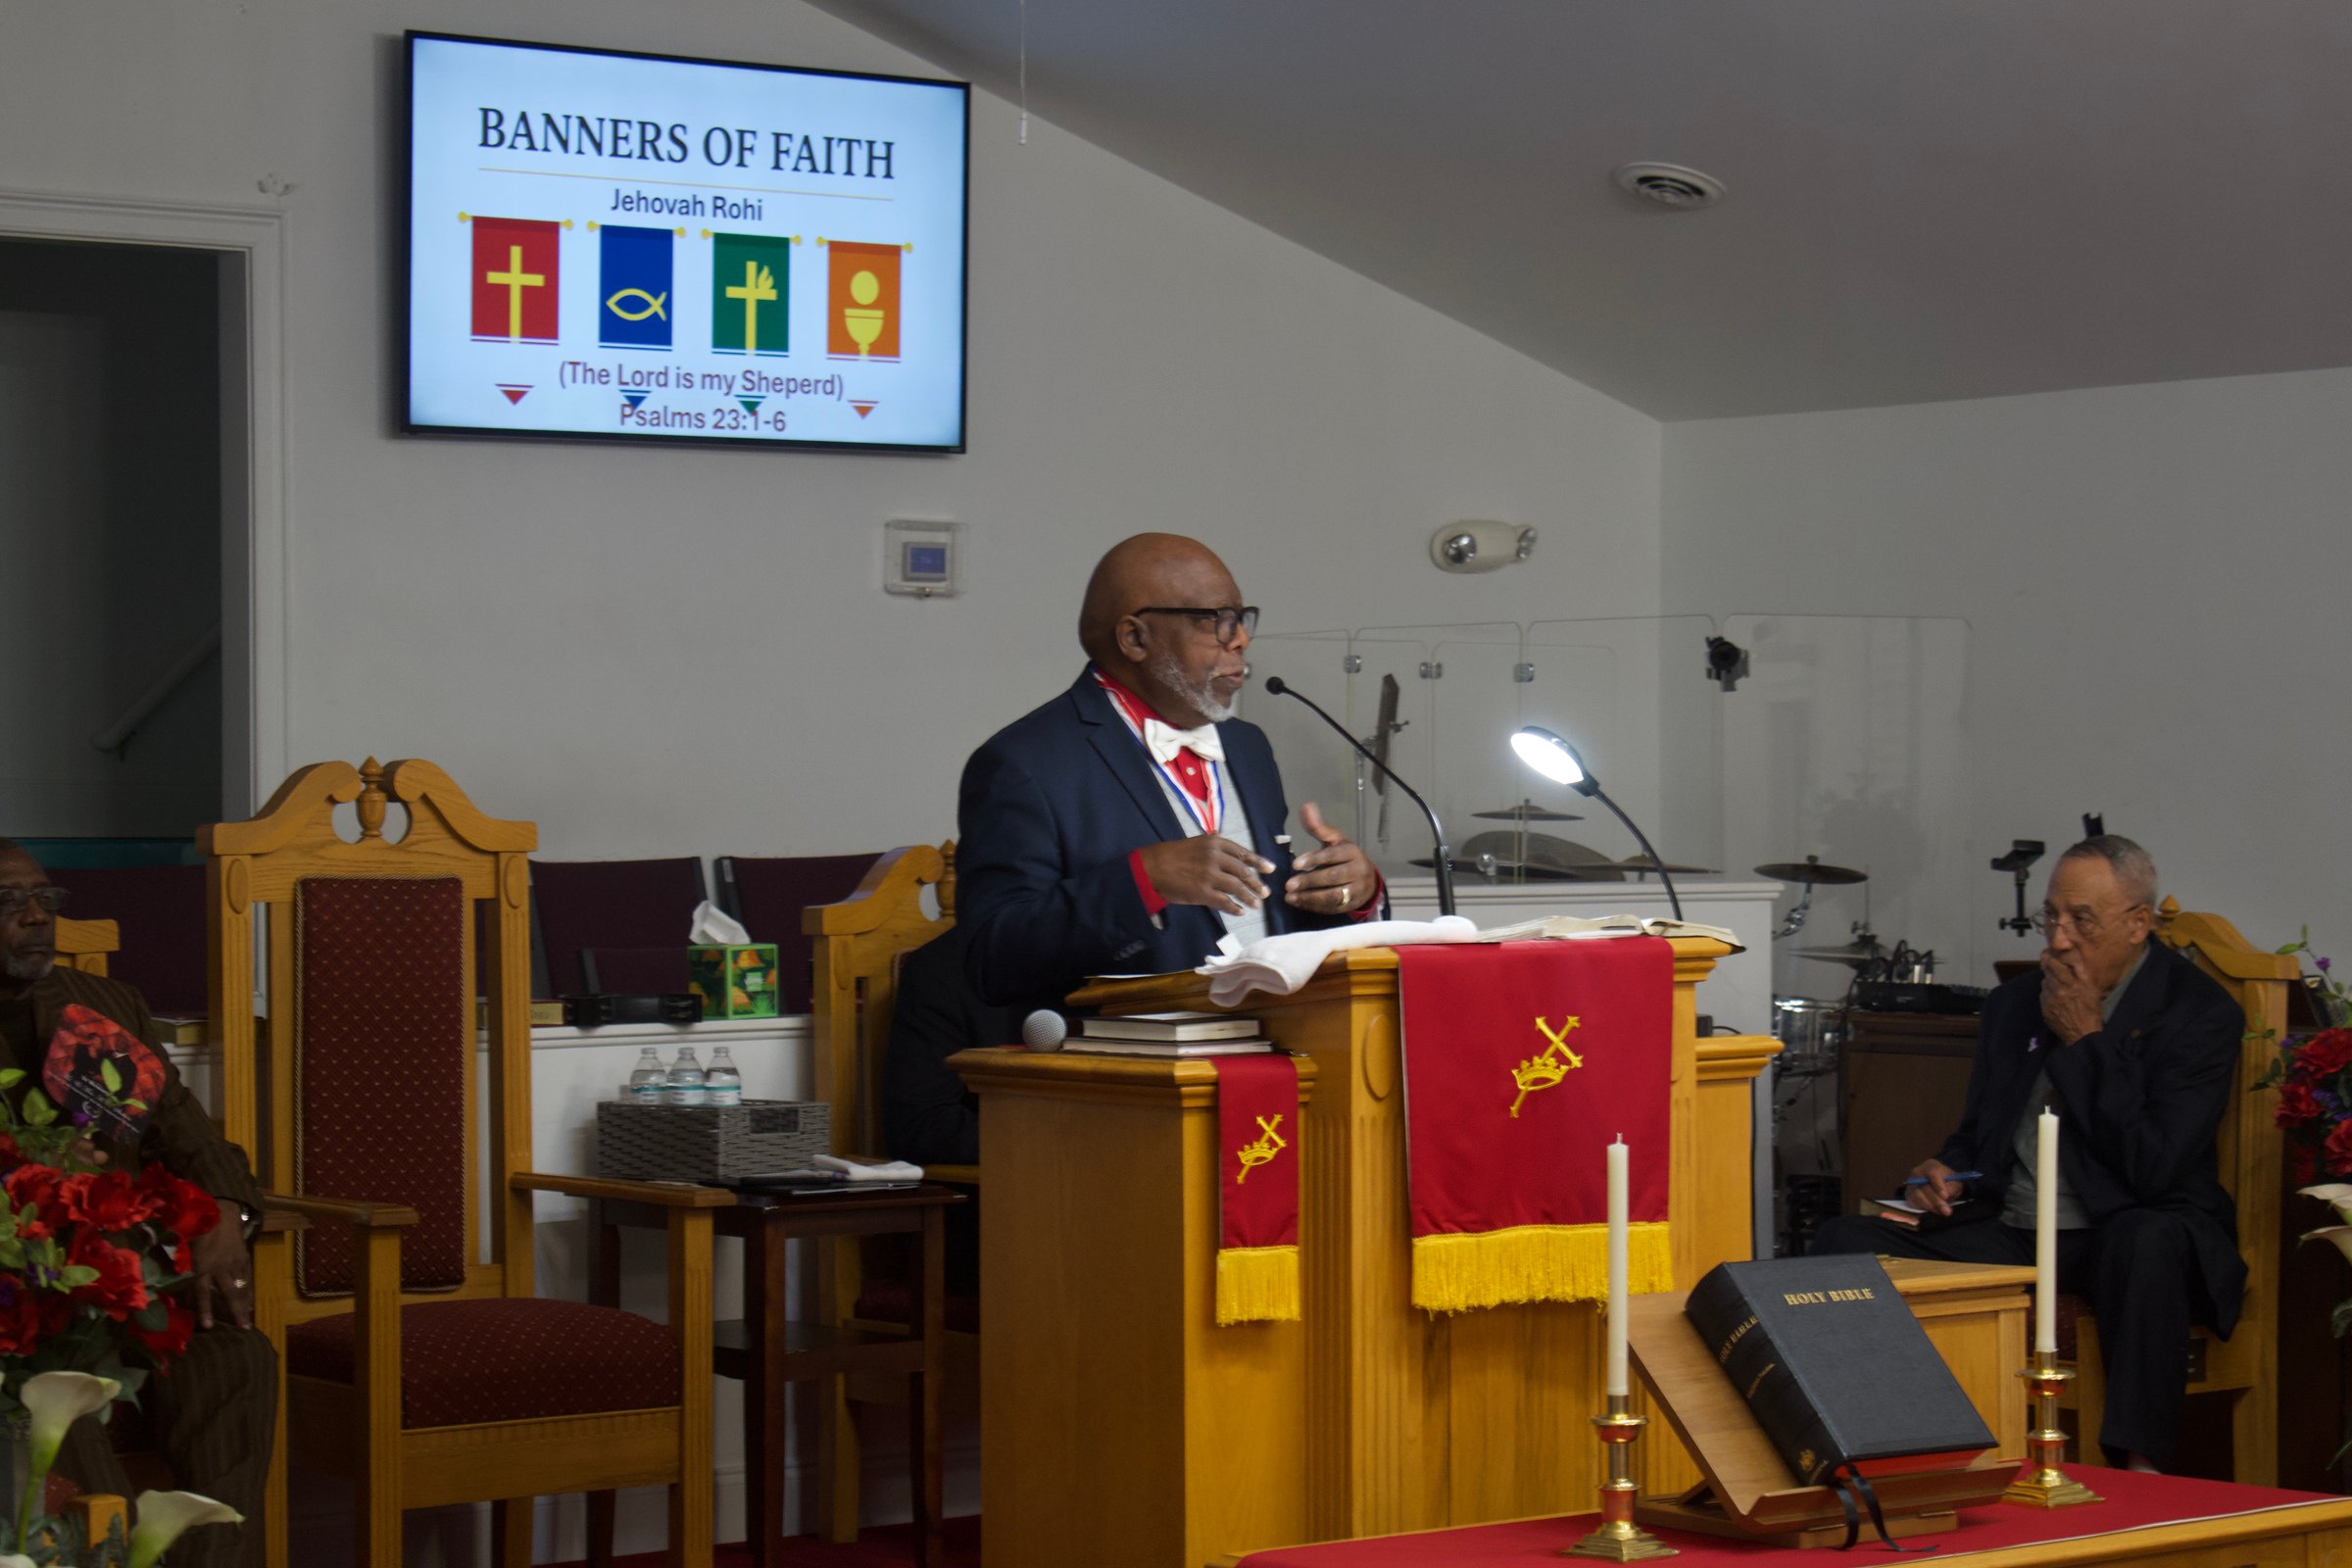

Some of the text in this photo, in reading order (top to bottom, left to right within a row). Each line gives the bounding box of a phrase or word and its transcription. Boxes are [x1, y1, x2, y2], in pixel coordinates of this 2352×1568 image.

[478, 107, 896, 179] BANNERS OF FAITH
[611, 188, 762, 221] Jehovah Rohi
[559, 361, 844, 402] (The Lord is my Sheperd)
[619, 403, 787, 432] Psalms 23:1-6
[1783, 1288, 1876, 1306] HOLY BIBLE
